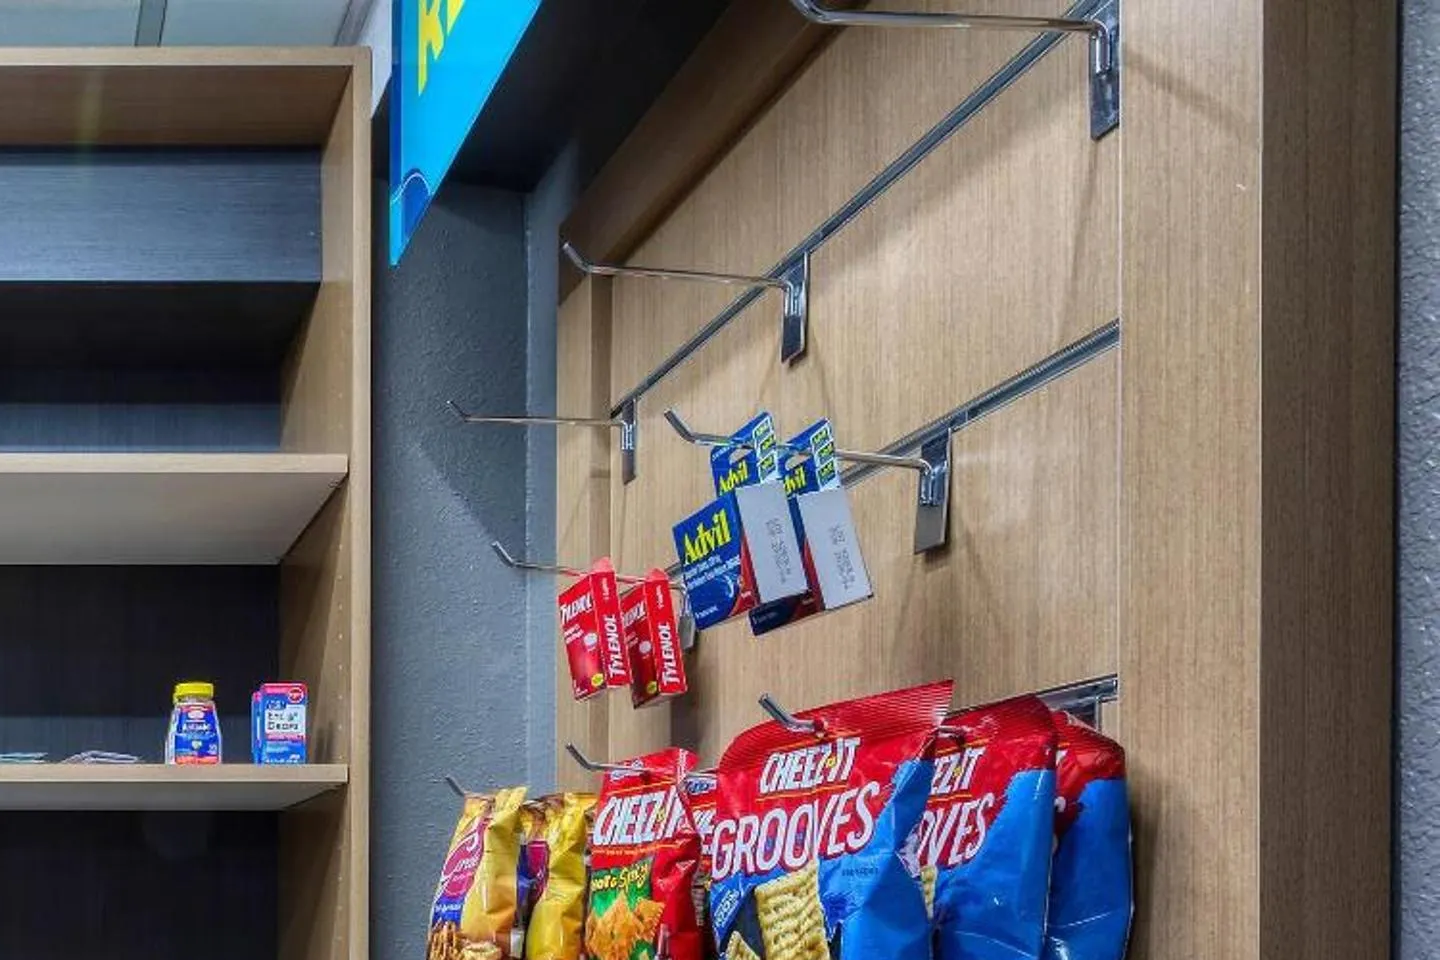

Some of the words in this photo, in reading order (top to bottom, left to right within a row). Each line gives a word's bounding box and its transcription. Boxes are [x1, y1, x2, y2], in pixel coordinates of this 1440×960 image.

[719, 460, 749, 496] Advil
[783, 466, 807, 496] dvil
[683, 508, 732, 566] Advil
[604, 614, 627, 679] TYLENOL
[658, 621, 681, 686] TYLENOL
[710, 780, 881, 881] GROOVES
